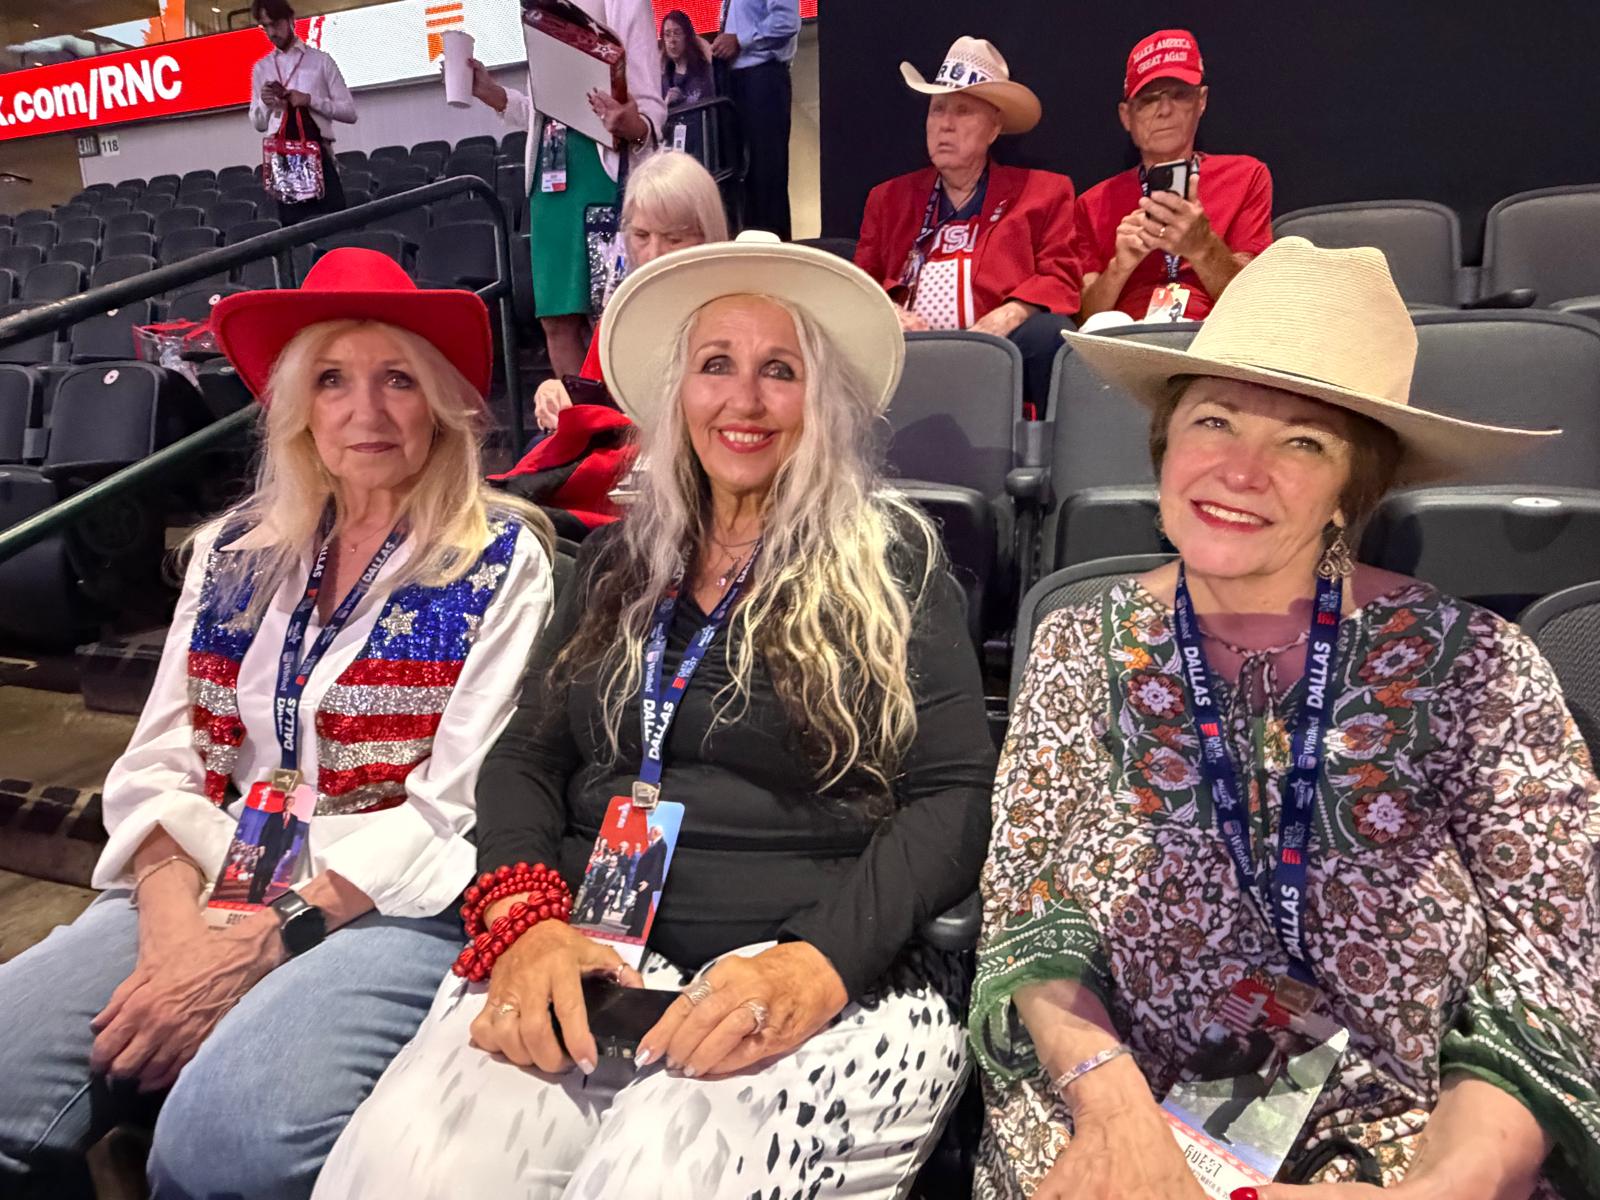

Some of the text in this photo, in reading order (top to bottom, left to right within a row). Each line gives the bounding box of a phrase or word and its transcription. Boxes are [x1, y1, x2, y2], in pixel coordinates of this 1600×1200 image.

[312, 545, 329, 578] ALLAS
[362, 541, 396, 583] DALLAS
[1184, 646, 1211, 707] DALLAS
[1306, 640, 1331, 709] DALLAS
[283, 697, 296, 751] DALLAS
[643, 699, 656, 742] DALL
[648, 701, 675, 760] DALLAS
[1303, 715, 1319, 755] WinRed
[1231, 834, 1254, 876] WinRed
[1281, 884, 1304, 961] DALLAS
[1184, 1144, 1222, 1178] GUEST
